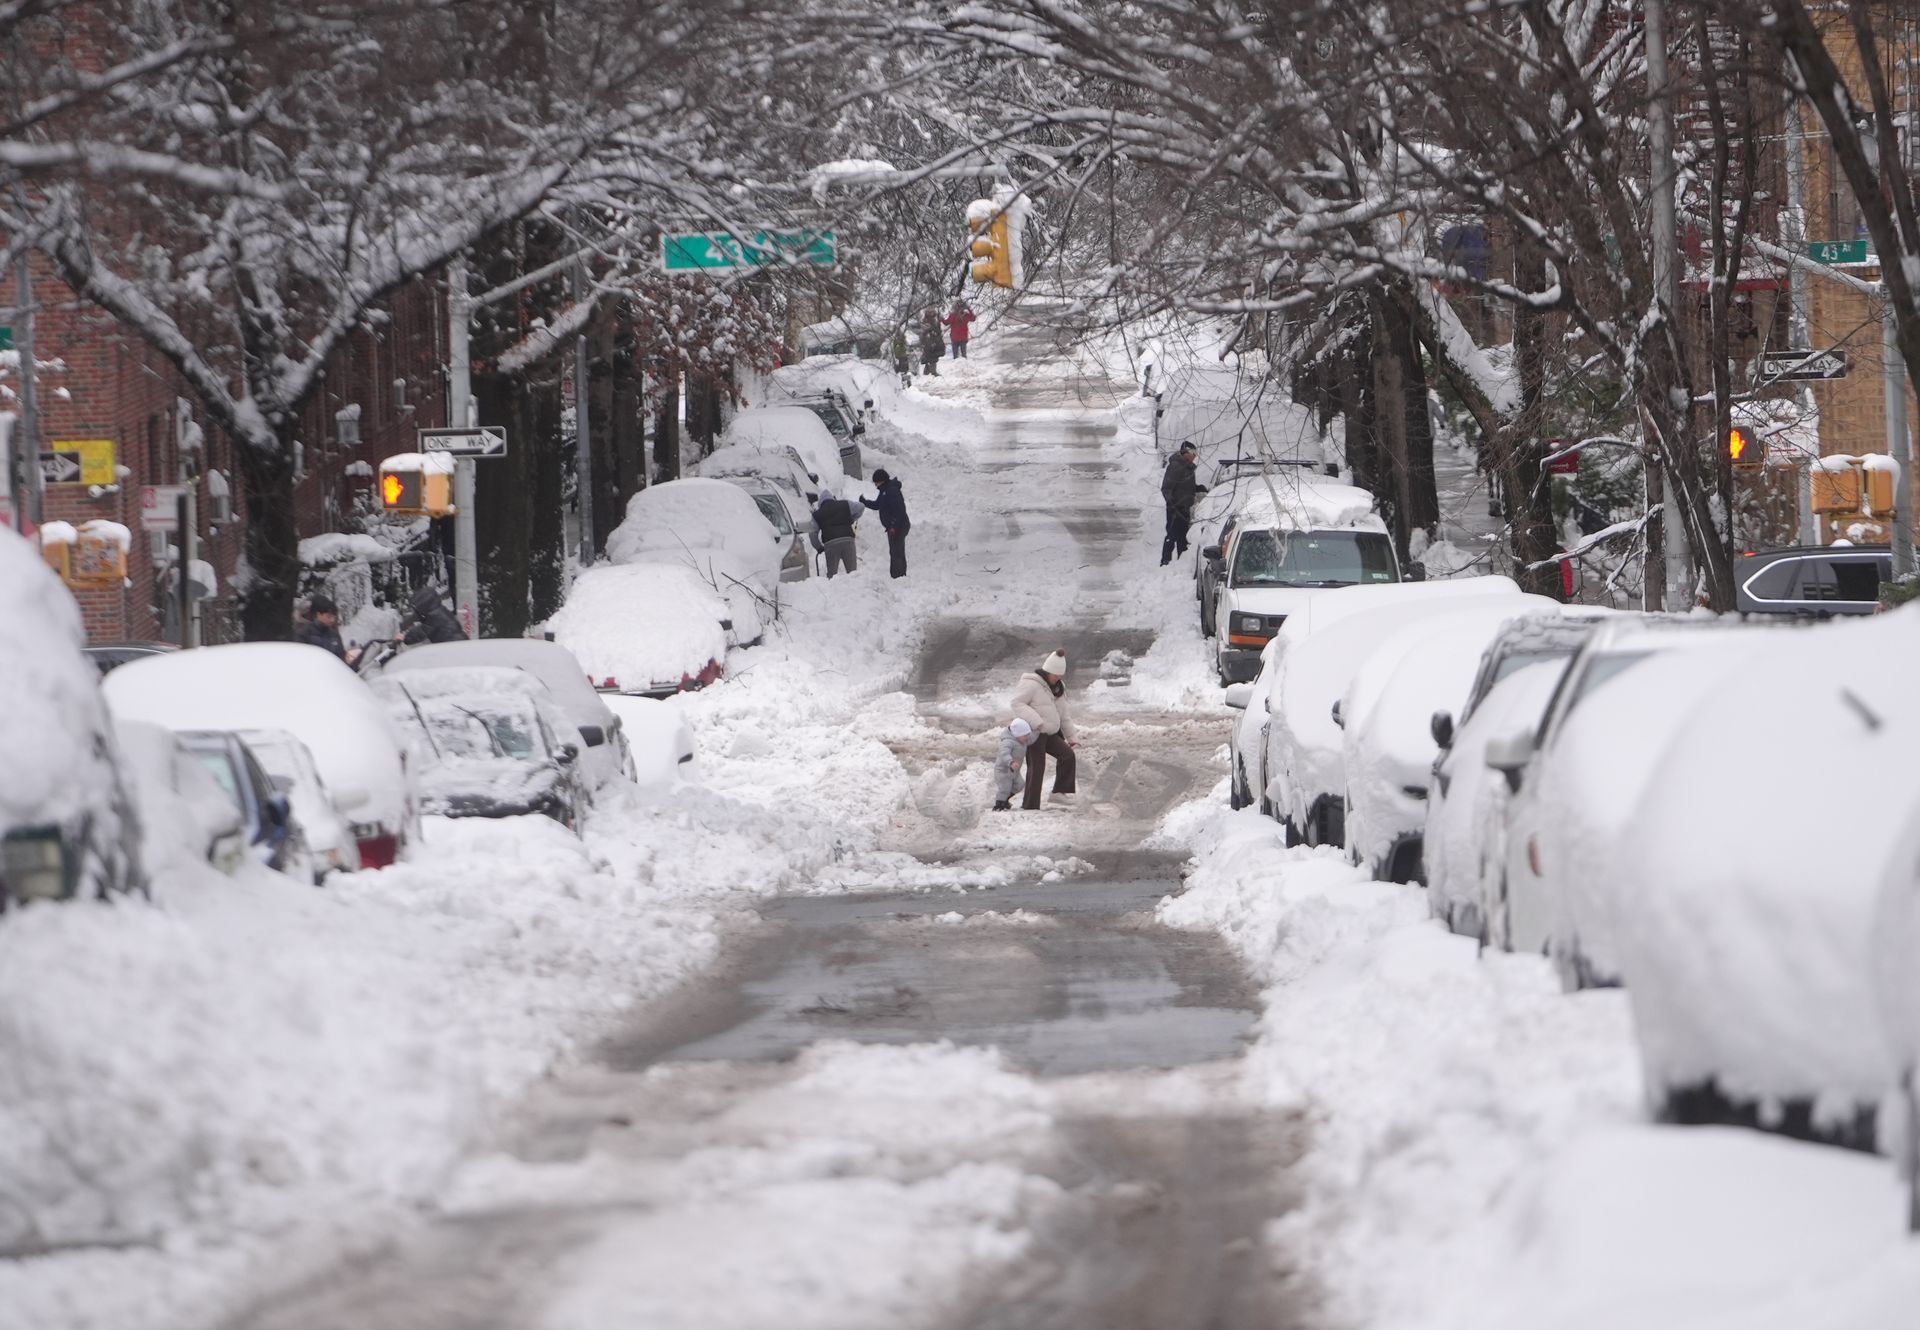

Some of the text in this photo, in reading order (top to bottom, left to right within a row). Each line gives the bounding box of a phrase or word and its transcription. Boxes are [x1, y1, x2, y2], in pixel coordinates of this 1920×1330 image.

[1821, 244, 1838, 260] 43
[428, 435, 491, 448] ONE WAY
